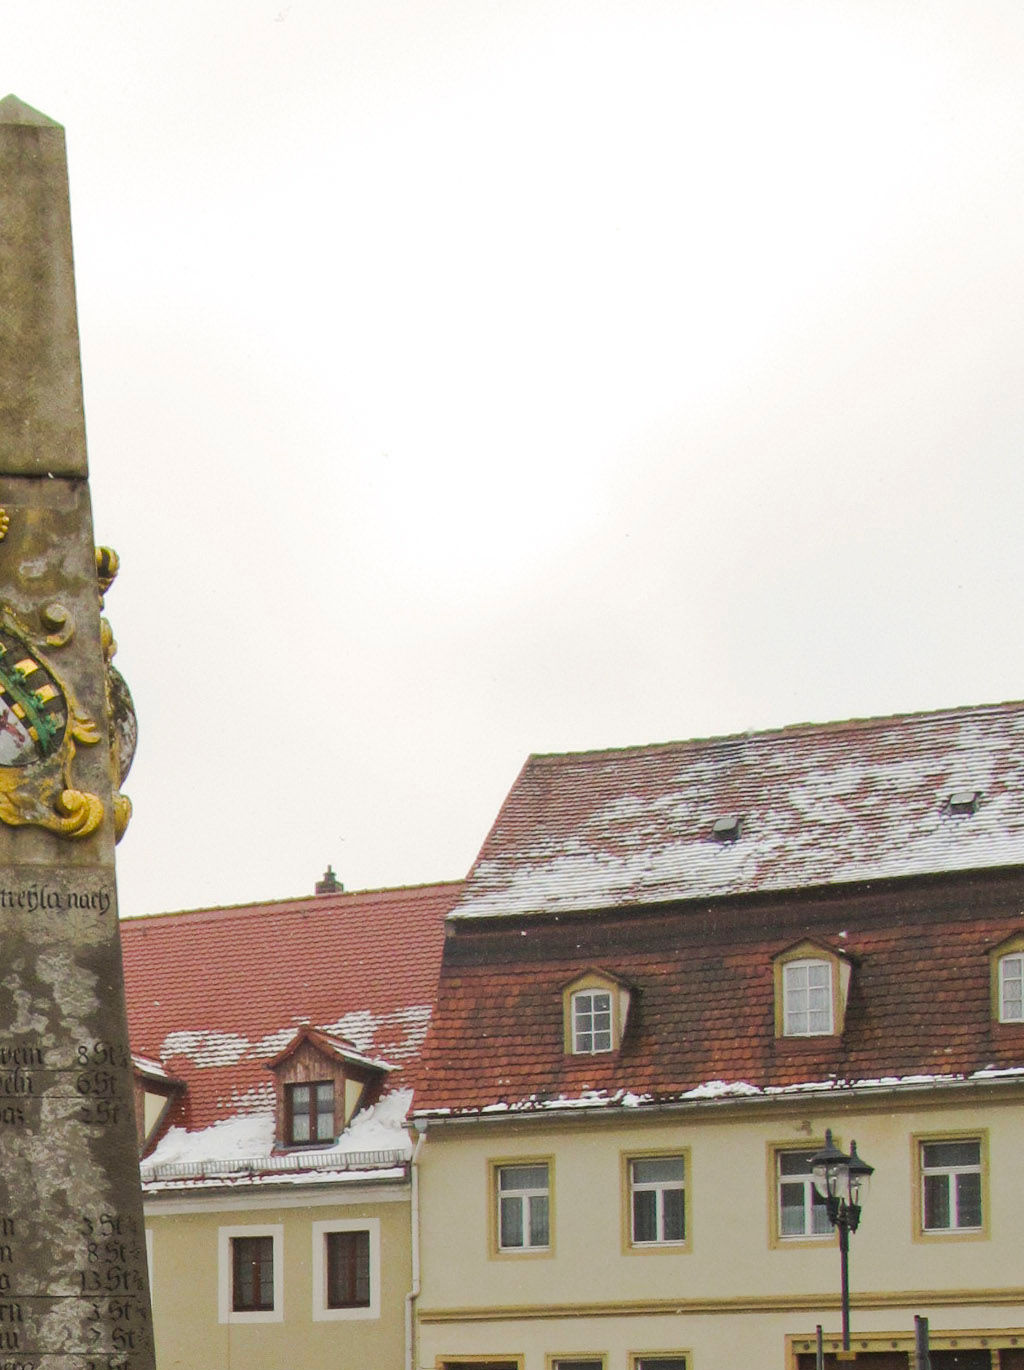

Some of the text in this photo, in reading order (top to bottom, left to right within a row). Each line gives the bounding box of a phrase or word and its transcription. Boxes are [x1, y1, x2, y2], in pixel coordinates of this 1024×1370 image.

[67, 886, 111, 915] nach
[78, 1045, 89, 1065] 8
[77, 1072, 91, 1095] 6
[81, 1216, 94, 1236] 3
[87, 1242, 98, 1263] 8
